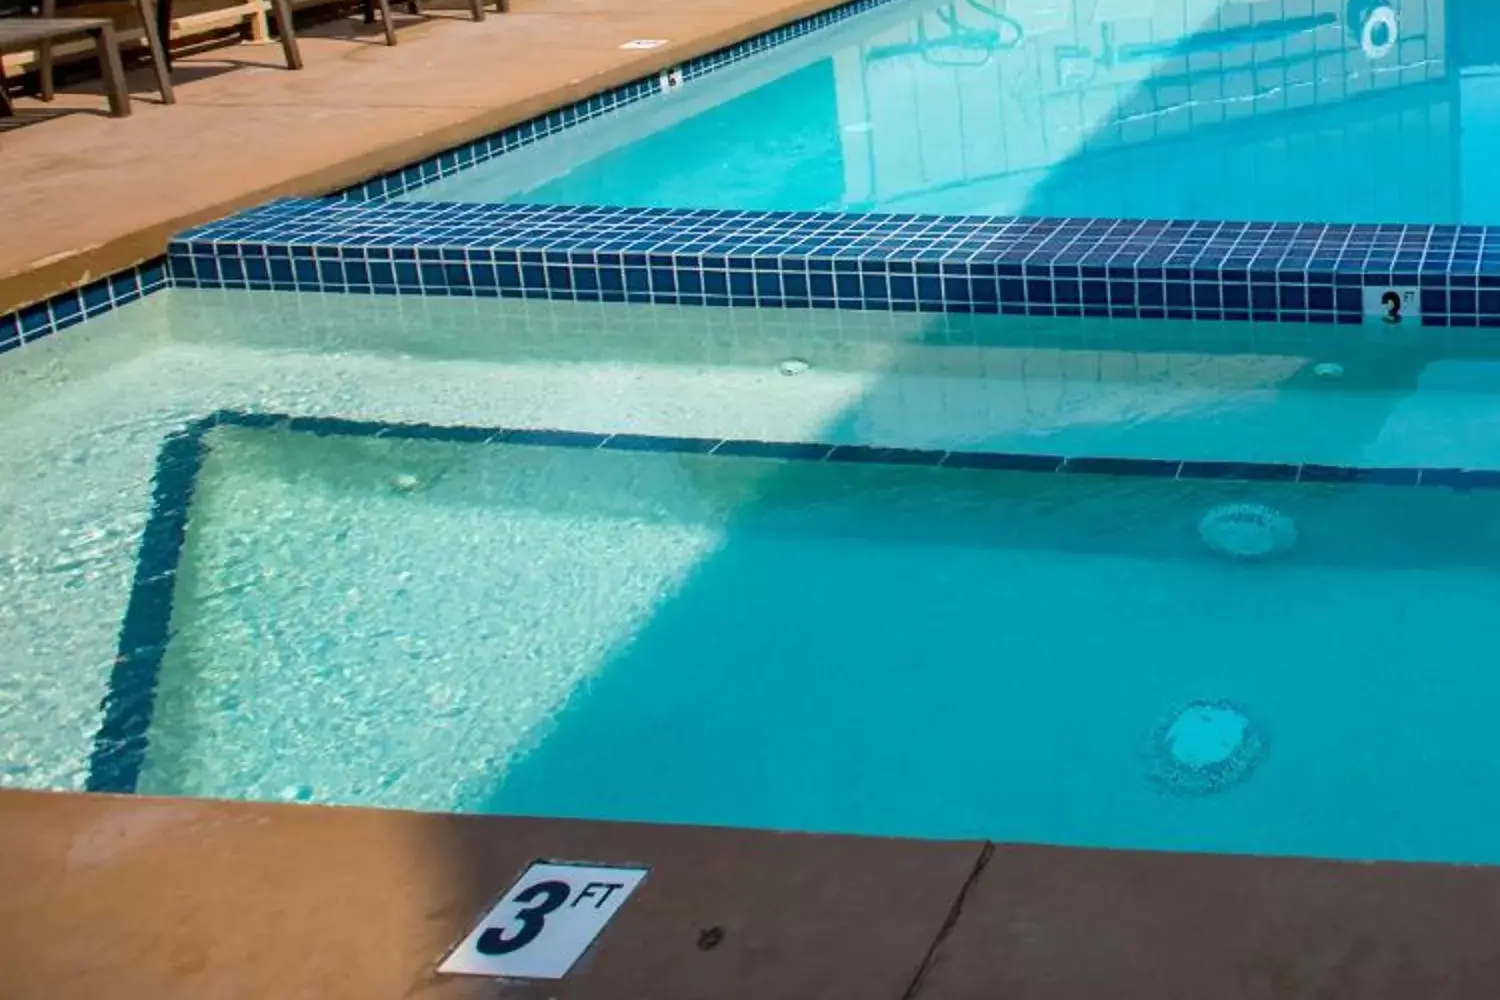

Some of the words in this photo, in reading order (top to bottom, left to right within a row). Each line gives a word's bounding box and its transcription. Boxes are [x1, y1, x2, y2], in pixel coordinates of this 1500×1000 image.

[1381, 290, 1402, 324] 3
[476, 880, 571, 956] 3
[571, 881, 624, 909] FT
